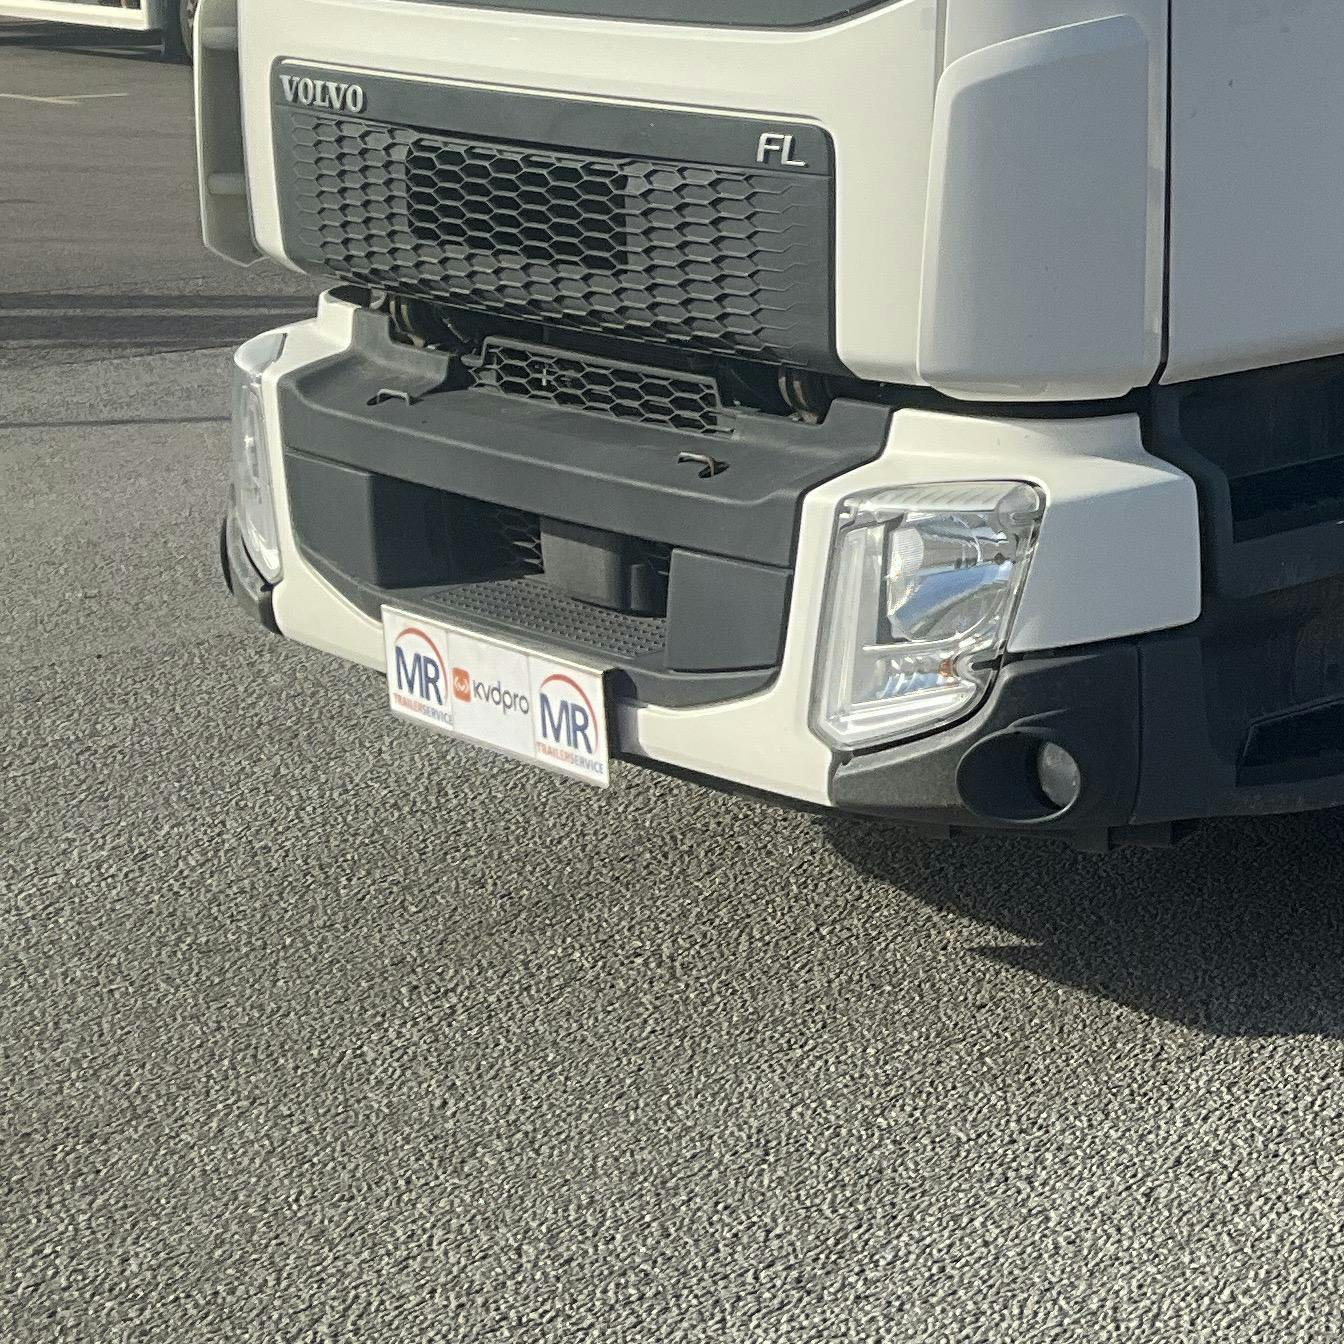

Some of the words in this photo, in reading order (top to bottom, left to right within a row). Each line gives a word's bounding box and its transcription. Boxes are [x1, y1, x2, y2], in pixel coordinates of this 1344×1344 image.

[279, 74, 364, 114] VOLVO
[756, 132, 807, 167] FL
[395, 645, 443, 706] MR
[472, 680, 530, 715] kvdpro
[538, 692, 593, 754] MR
